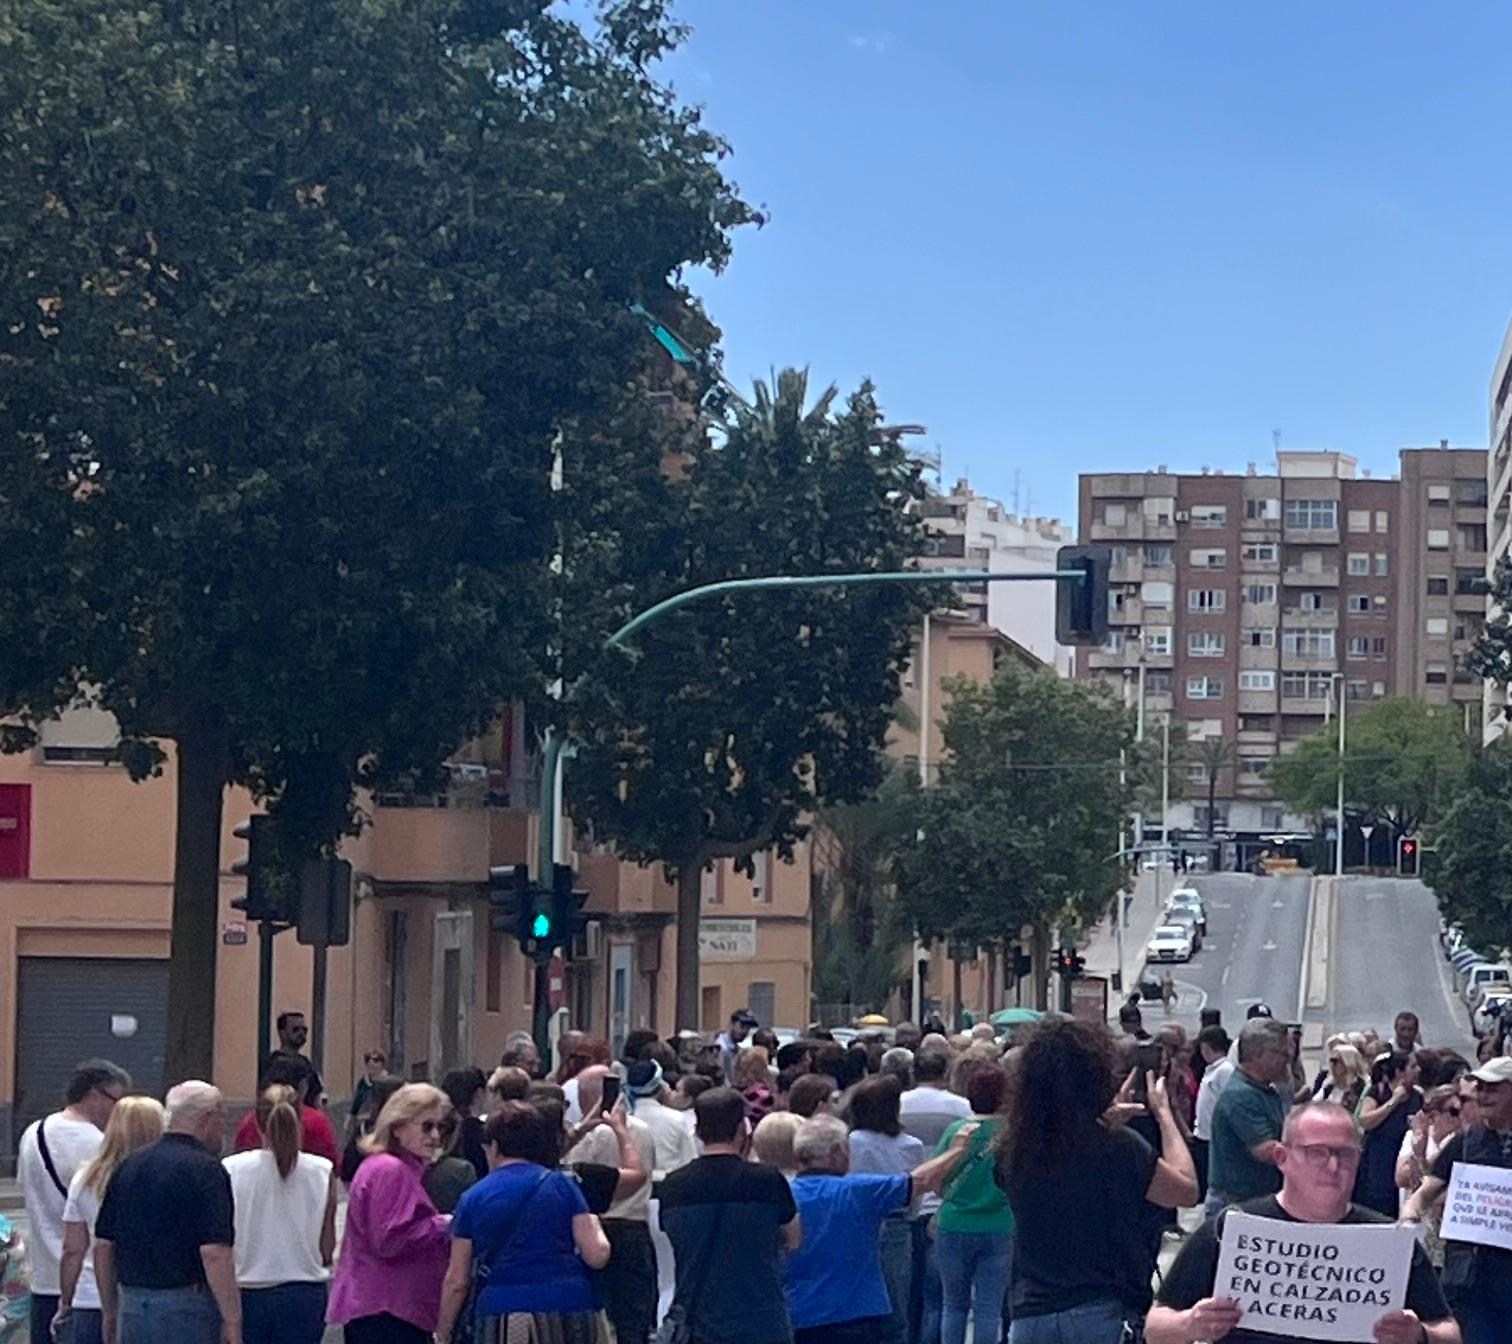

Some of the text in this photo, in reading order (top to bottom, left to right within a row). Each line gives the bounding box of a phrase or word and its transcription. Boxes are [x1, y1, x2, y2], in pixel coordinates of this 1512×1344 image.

[1237, 1233, 1339, 1261] ESTUDIO
[1233, 1255, 1386, 1285] GEOTÉCNICO
[1230, 1275, 1391, 1307] EN CALZADAS
[1248, 1299, 1338, 1324] ACERAS
